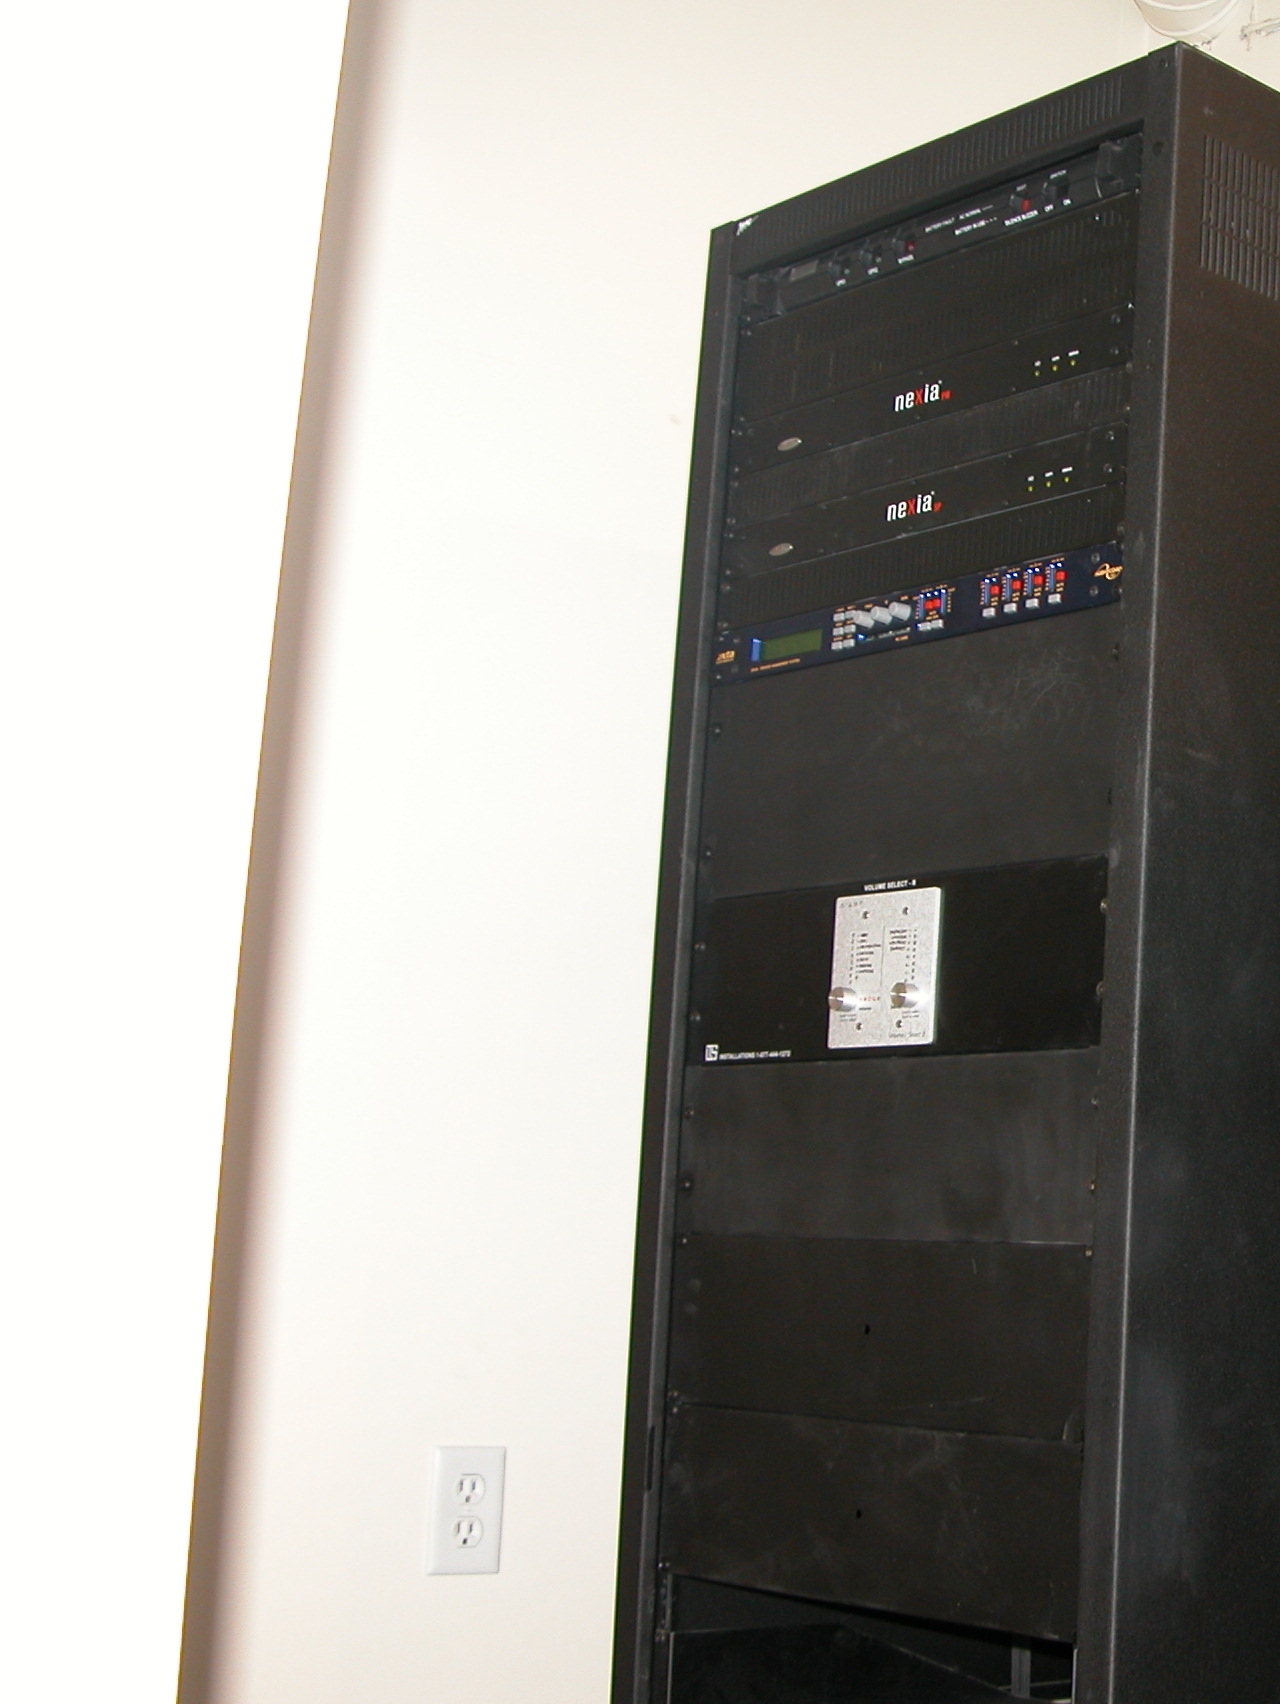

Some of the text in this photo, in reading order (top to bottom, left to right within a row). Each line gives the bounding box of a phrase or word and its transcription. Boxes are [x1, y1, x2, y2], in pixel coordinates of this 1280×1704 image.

[895, 383, 940, 412] nexia
[887, 494, 932, 521] nexia
[863, 882, 886, 892] VOLUME
[887, 880, 908, 889] SELECT
